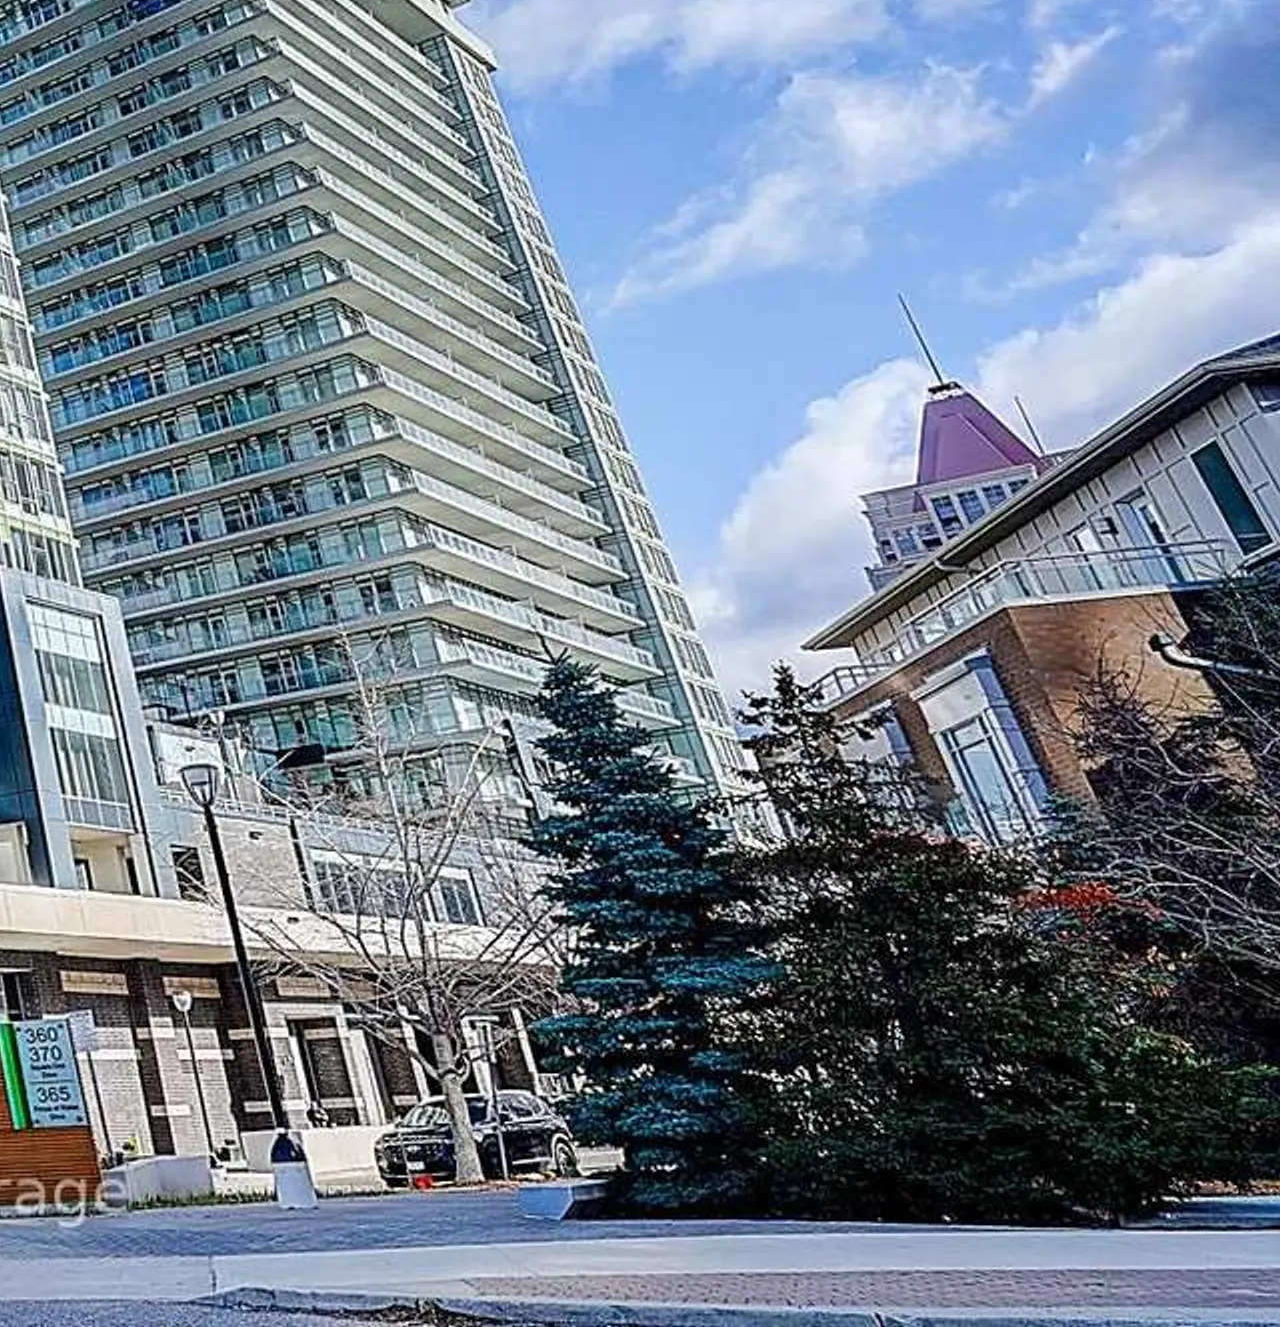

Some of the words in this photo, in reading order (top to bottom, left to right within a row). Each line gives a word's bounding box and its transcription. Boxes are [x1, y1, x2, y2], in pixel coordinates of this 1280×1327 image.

[24, 1027, 58, 1044] 360
[29, 1045, 62, 1062] 370
[36, 1086, 71, 1103] 365
